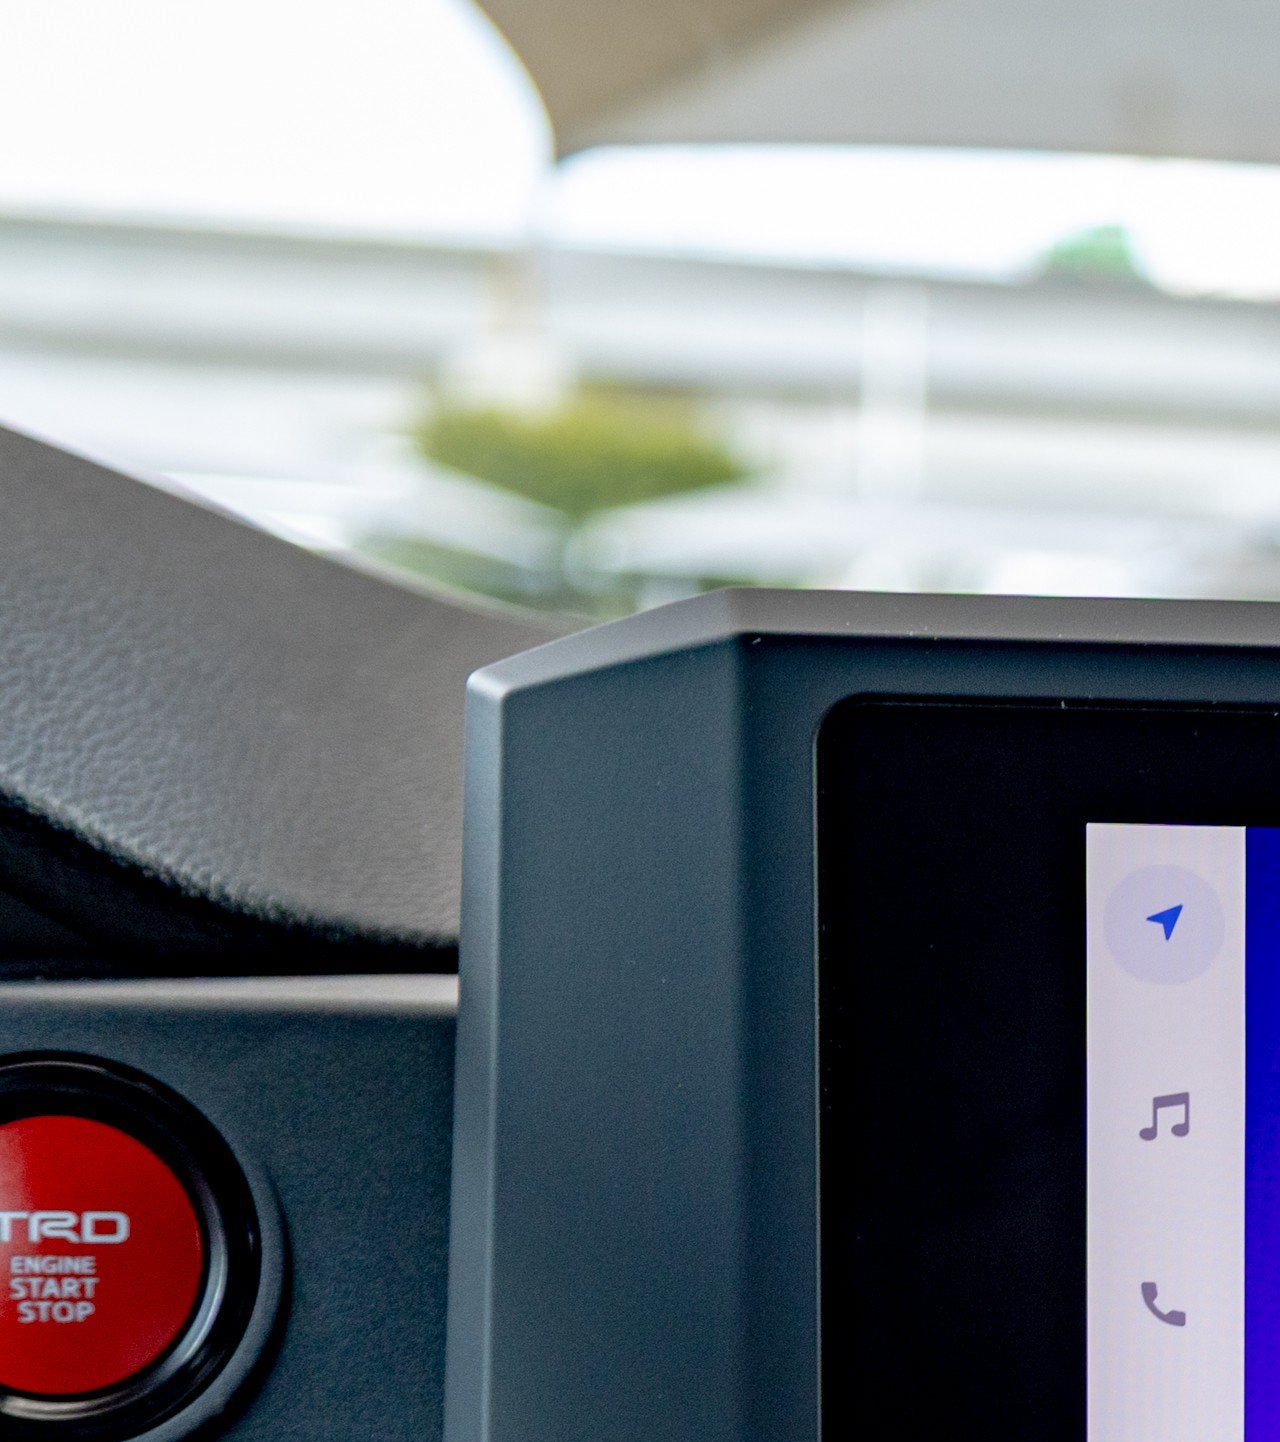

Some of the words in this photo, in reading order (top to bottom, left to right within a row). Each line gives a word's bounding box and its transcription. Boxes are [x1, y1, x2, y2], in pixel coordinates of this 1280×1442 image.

[0, 1210, 130, 1244] TRD
[10, 1255, 97, 1275] ENGINE
[10, 1276, 99, 1299] START
[17, 1300, 96, 1323] STOP
